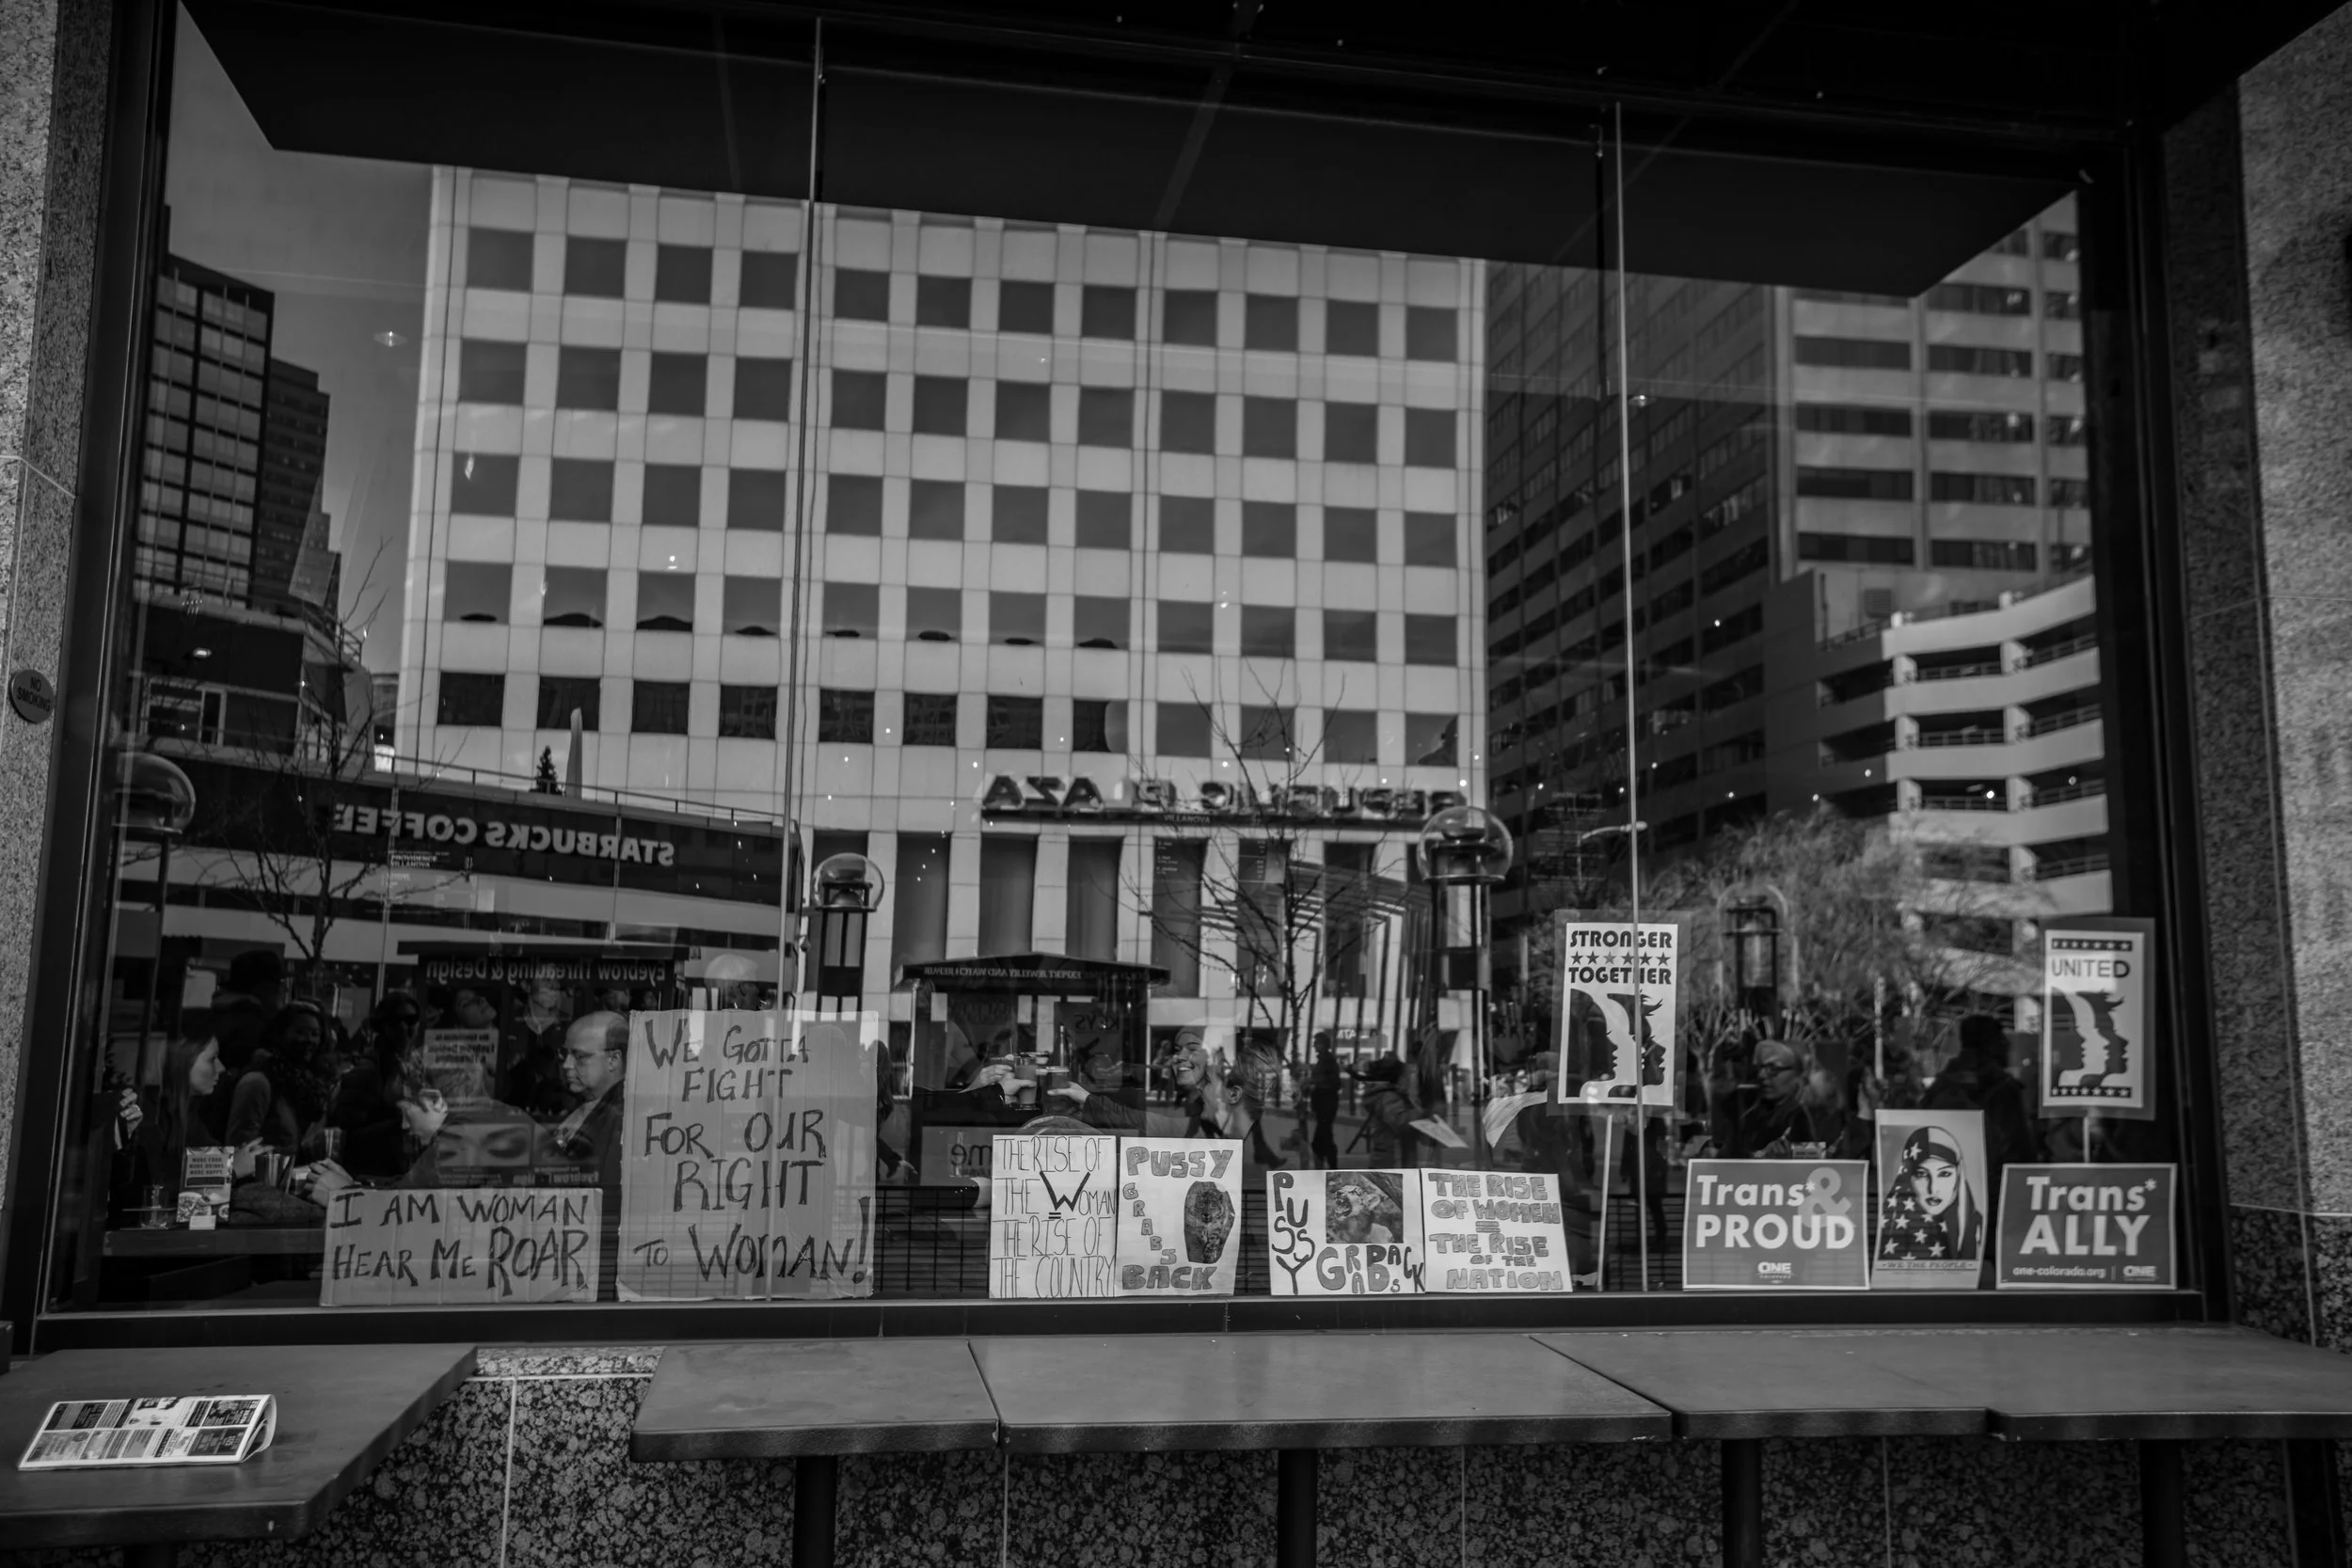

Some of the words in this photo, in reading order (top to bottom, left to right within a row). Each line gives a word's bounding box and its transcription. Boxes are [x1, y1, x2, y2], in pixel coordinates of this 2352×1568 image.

[30, 676, 41, 691] NO
[17, 687, 51, 712] SMOKING
[1163, 815, 1211, 825] VILLANOVA
[1569, 929, 1673, 948] STRONGER
[2051, 958, 2131, 978] UNITED
[644, 1018, 700, 1069] WE
[723, 1024, 811, 1066] GOTTA
[681, 1067, 794, 1103] FIGHT
[644, 1112, 715, 1159] FOR
[744, 1108, 827, 1158] OUR
[994, 1138, 1031, 1171] THE
[1031, 1135, 1082, 1172] RISE
[1085, 1137, 1112, 1172] OF
[1125, 1146, 1234, 1179] PUSSY
[673, 1157, 825, 1212] RIGHT
[993, 1178, 1041, 1214] THE
[1040, 1170, 1116, 1216] WOMAN
[1428, 1172, 1481, 1198] THE
[1486, 1174, 1548, 1201] RISE
[329, 1192, 364, 1228] I
[379, 1193, 440, 1227] AM
[457, 1194, 588, 1226] WOMAN
[1431, 1199, 1469, 1220] OF
[1473, 1198, 1561, 1225] WOMEN
[993, 1219, 1029, 1258] THE
[1028, 1215, 1075, 1258] RISE
[1083, 1216, 1112, 1257] OF
[1429, 1232, 1481, 1254] THE
[1489, 1232, 1549, 1257] RISE
[1695, 1213, 1855, 1250] PROUD
[2019, 1214, 2151, 1257] ALLY
[332, 1243, 419, 1288] HEAR
[487, 1226, 589, 1297] ROAR
[632, 1238, 669, 1268] TO
[1470, 1254, 1493, 1265] OF
[1502, 1255, 1537, 1267] THE
[1757, 1261, 1792, 1274] ONE
[992, 1257, 1026, 1299] THE
[1035, 1255, 1116, 1298] COUNTRY
[1121, 1264, 1217, 1291] BACK
[1446, 1267, 1563, 1291] NATION
[2012, 1265, 2106, 1279] one-colorado.org
[2122, 1265, 2158, 1276] ONE
